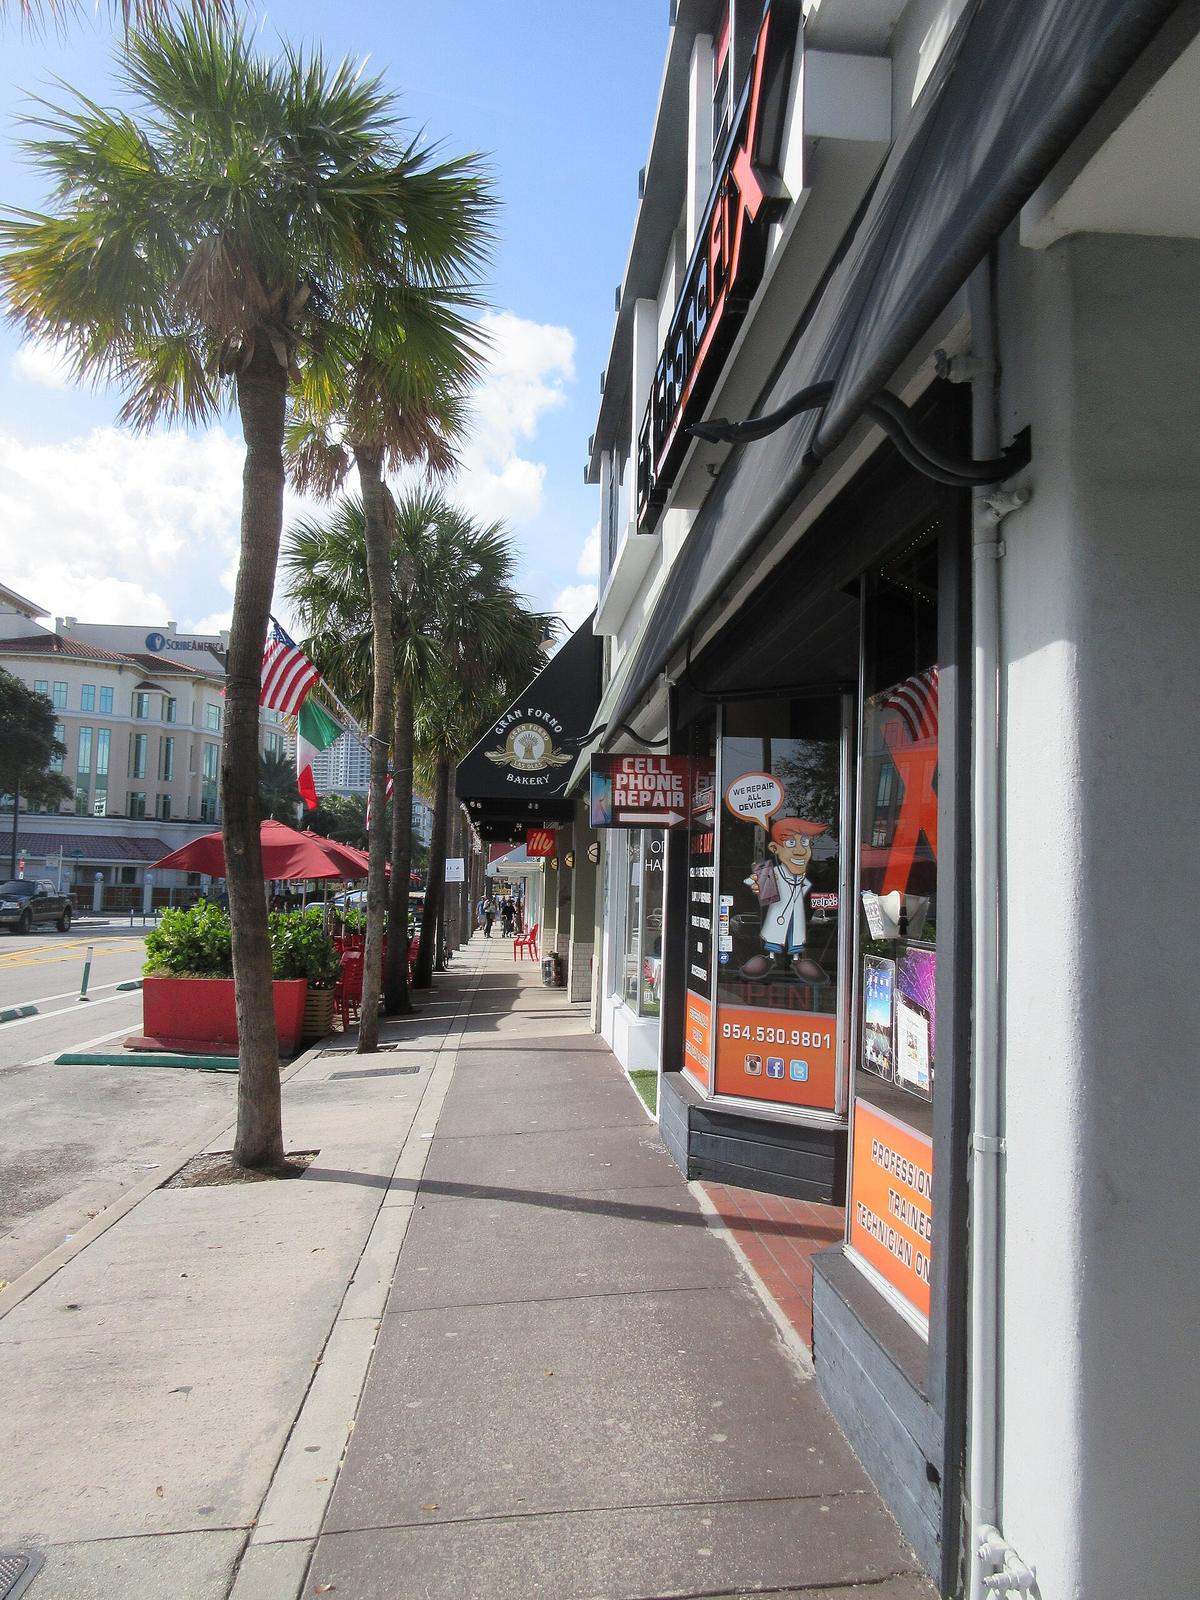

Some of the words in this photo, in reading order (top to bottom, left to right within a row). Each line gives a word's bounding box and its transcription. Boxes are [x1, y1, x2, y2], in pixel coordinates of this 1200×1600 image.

[495, 709, 523, 735] GRAN
[527, 708, 562, 733] FORNO
[509, 725, 526, 740] GRAN
[528, 725, 550, 741] FORNO
[622, 757, 673, 774] CELL
[506, 773, 550, 785] BAKERY
[616, 773, 683, 791] PHONE
[733, 787, 746, 796] WE
[746, 782, 774, 794] REPAIR
[747, 793, 762, 801] ALL
[614, 790, 684, 807] REPAIR
[738, 799, 772, 811] DEVICES
[528, 831, 553, 854] illy
[811, 897, 831, 908] yelp
[722, 1023, 831, 1048] 954.530.9801
[888, 1187, 932, 1243] TRAINED
[856, 1200, 913, 1269] TECHNICIAN
